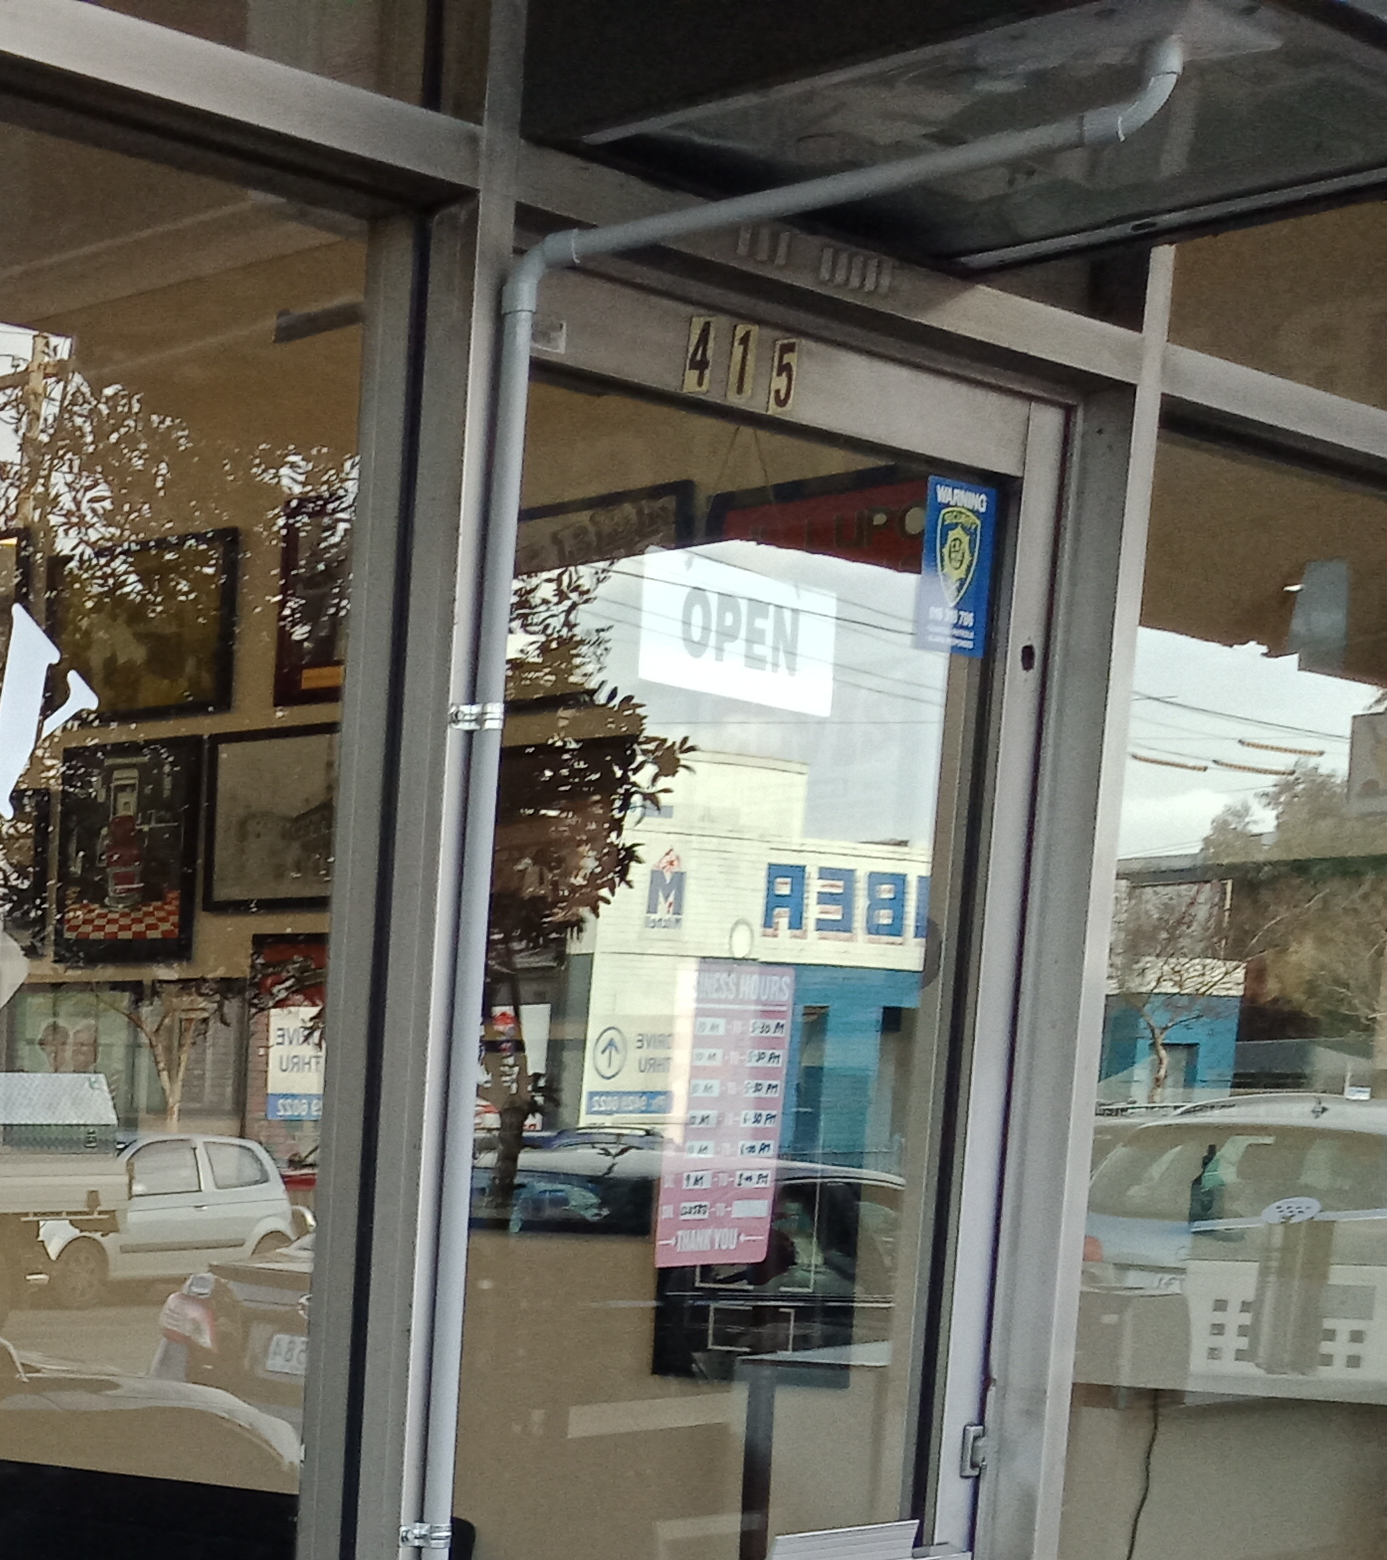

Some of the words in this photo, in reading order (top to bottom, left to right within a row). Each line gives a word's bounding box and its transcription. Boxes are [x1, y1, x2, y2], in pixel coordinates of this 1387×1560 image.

[688, 320, 797, 409] 415
[936, 484, 988, 513] WARNING
[681, 587, 800, 676] OPEN
[714, 1227, 738, 1250] YOU
